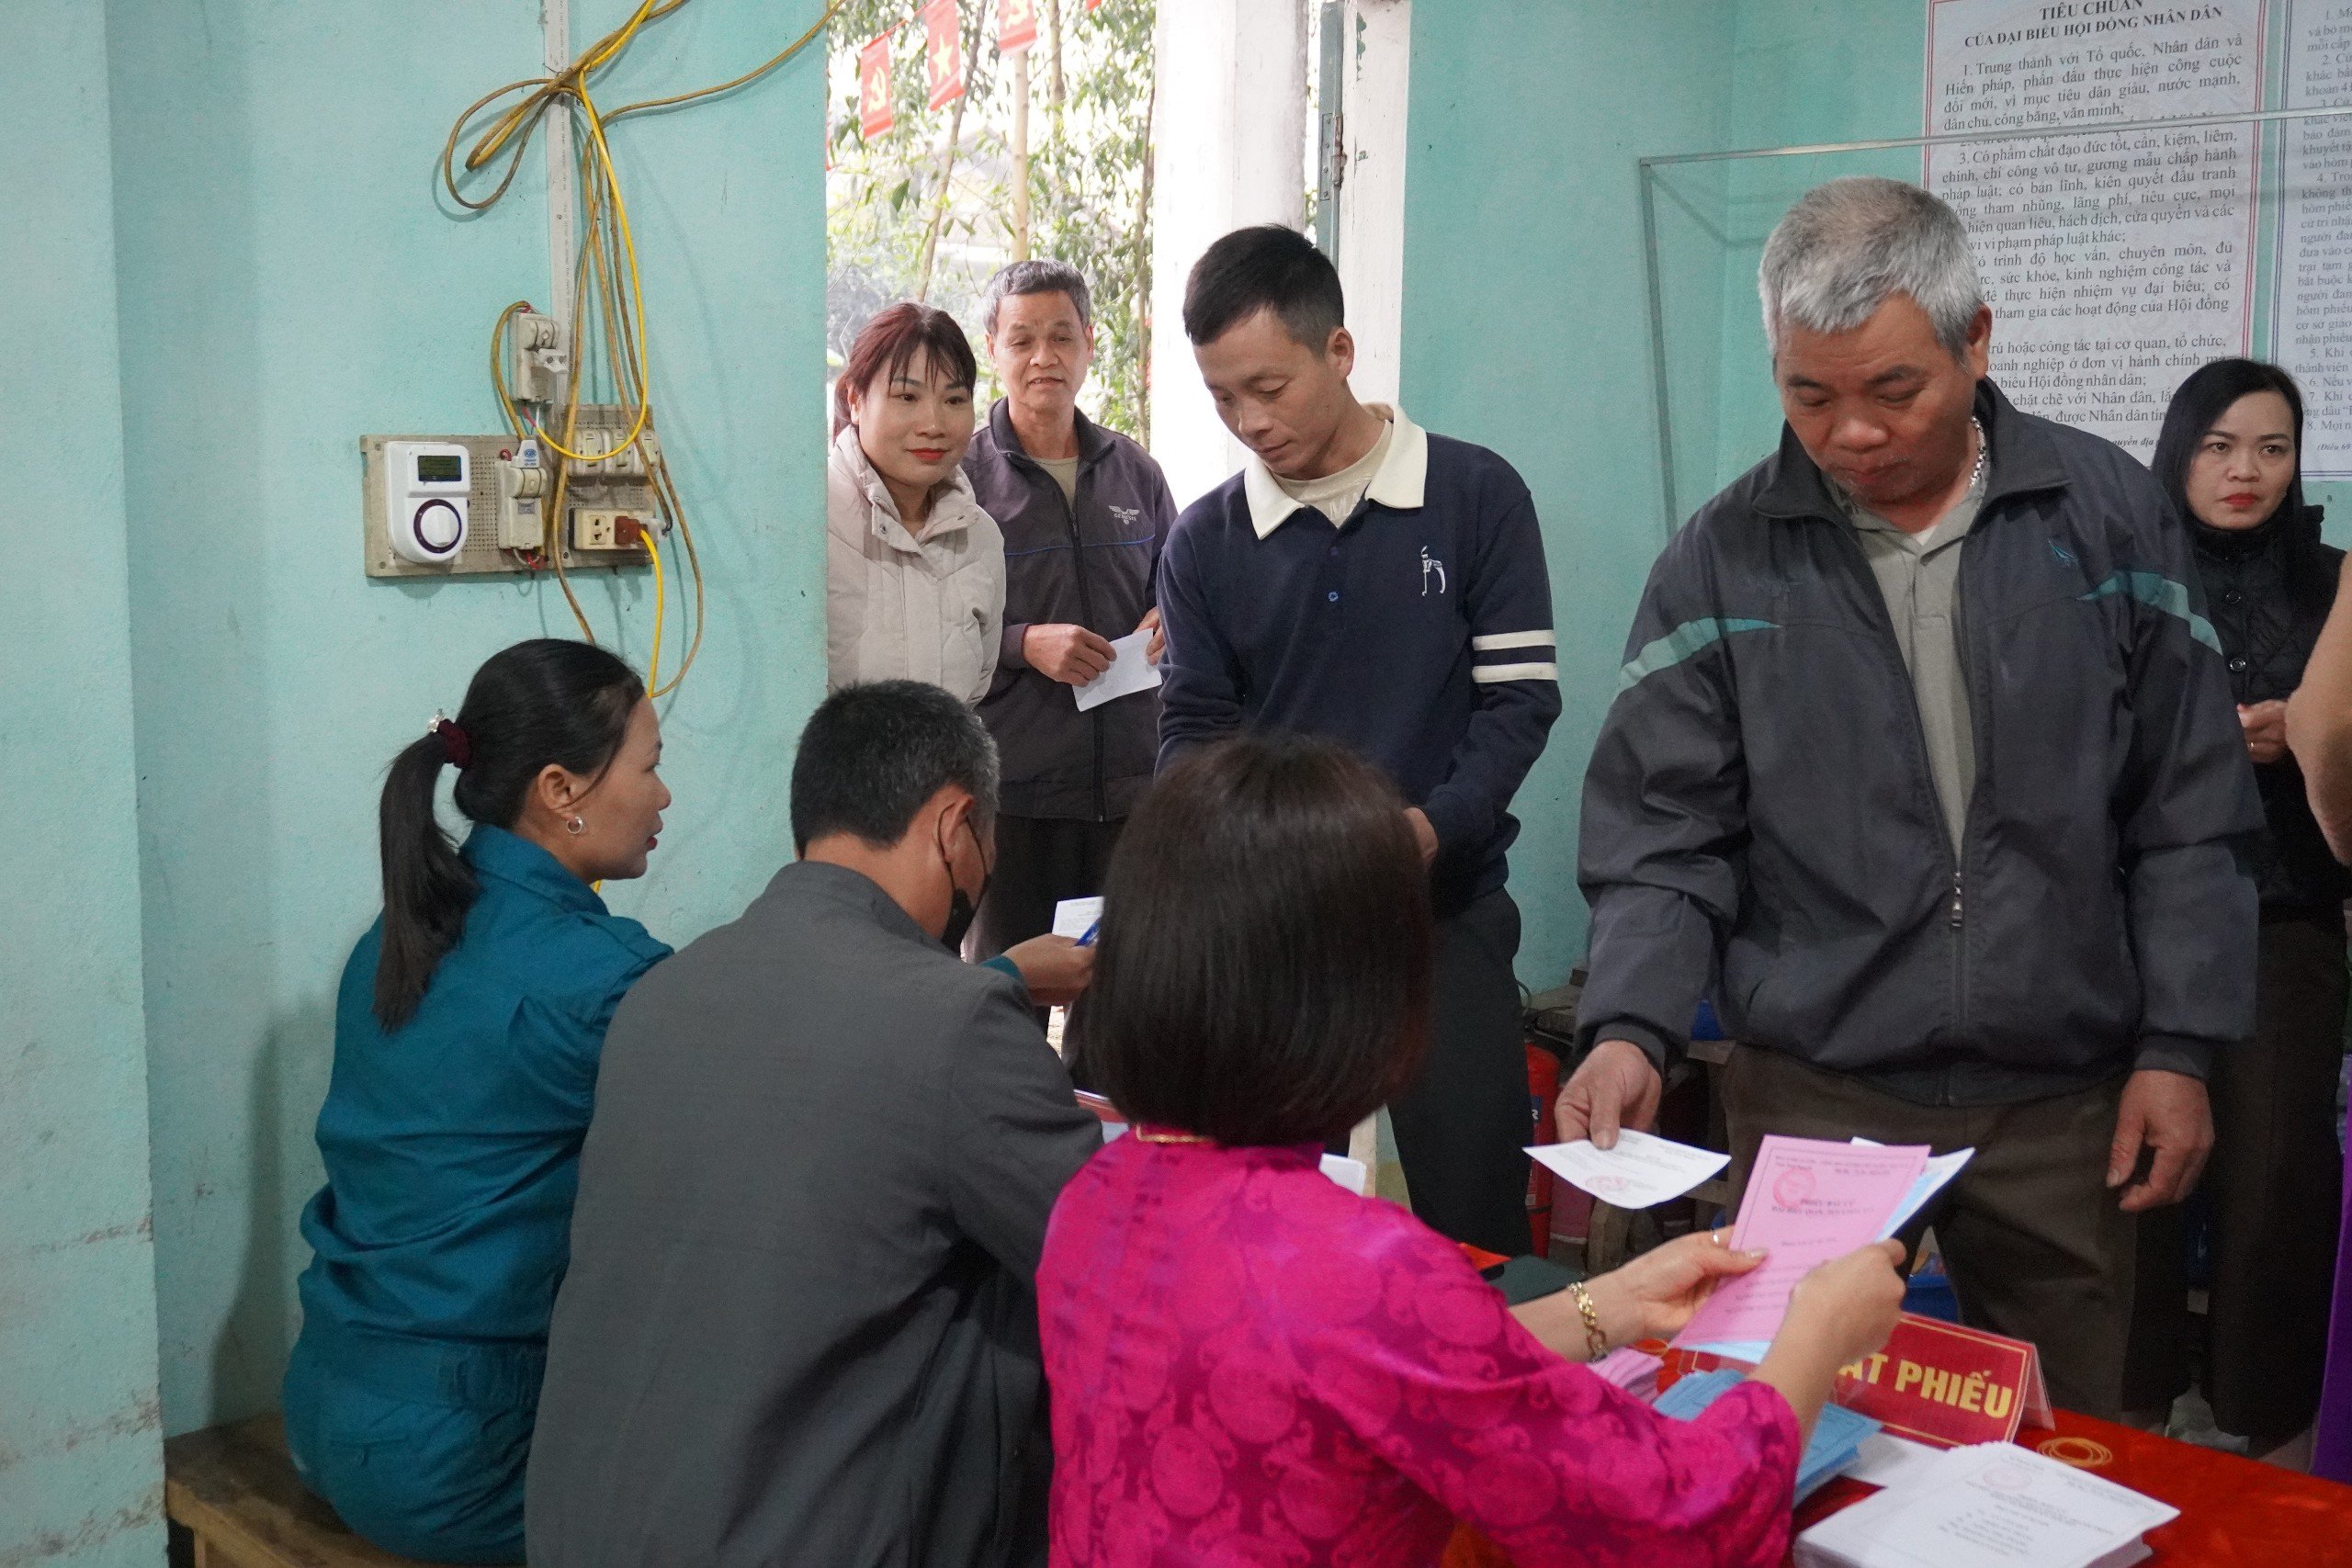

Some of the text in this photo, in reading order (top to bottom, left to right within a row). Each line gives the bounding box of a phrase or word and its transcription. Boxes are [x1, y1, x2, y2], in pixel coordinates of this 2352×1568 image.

[2064, 21, 2091, 37] HỘI
[2143, 8, 2186, 27] NHÂN
[2191, 5, 2222, 20] DÂN
[1977, 62, 2011, 75] Trung
[2019, 55, 2052, 70] thành
[2059, 51, 2079, 65] với
[2154, 41, 2188, 55] Nhân
[2195, 37, 2219, 51] dân
[1946, 54, 2242, 96] Hiến pháp, phấn thực hiện công cuộc
[1971, 98, 1996, 111] mới,
[2023, 94, 2050, 106] mục
[2058, 89, 2080, 101] tiêu
[2088, 85, 2110, 99] dân
[2159, 77, 2191, 91] nước
[1944, 103, 2124, 131] dân công văn minh;
[1959, 153, 1970, 164] 3.
[1973, 150, 1989, 164] Có
[2030, 142, 2054, 158] chất
[2058, 143, 2080, 158] đạo
[2084, 141, 2107, 153] đức
[2110, 136, 2131, 152] tốt,
[2164, 134, 2199, 147] kiệm,
[1942, 170, 1978, 183] chính,
[1984, 166, 2001, 179] chí
[2007, 164, 2038, 179] công
[2044, 163, 2059, 175] vô
[2064, 164, 2081, 174] tư,
[2087, 159, 2128, 175] gương
[2167, 148, 2199, 166] chấp
[2205, 147, 2236, 162] hành
[1942, 165, 2235, 202] pháp luật; có lĩnh, kiên quyết đấu tranh
[1984, 202, 2014, 214] tham
[2141, 190, 2165, 204] tiêu
[2174, 190, 2200, 204] cực,
[2210, 187, 2234, 200] mọi
[1968, 205, 2234, 234] hiện quan liêu, hách dịch, và các
[1970, 231, 2125, 252] vi vi phạm pháp luật khác;
[1995, 243, 2206, 266] trình độ học vấn, chuyên môn,
[2001, 272, 2020, 284] sức
[2066, 268, 2092, 280] kinh
[2099, 265, 2146, 281] nghiệm
[2153, 264, 2184, 277] công
[2190, 261, 2209, 273] tác
[2005, 289, 2031, 302] thực
[2040, 287, 2065, 300] hiện
[2074, 285, 2112, 300] nhiệm
[2122, 286, 2136, 298] vụ
[2144, 282, 2164, 297] đại
[2214, 278, 2230, 290] có
[1996, 294, 2229, 320] tham gia các hoạt động Hội đồng
[2007, 333, 2226, 355] hoặc công tác tại cơ quan, chức,
[2325, 348, 2344, 357] Khi
[1989, 354, 2199, 373] oanh nghiệp vị hành chính
[2030, 373, 2146, 389] Hội đồng nhân dân;
[2013, 391, 2156, 408] chặt với Nhân dân,
[2324, 391, 2342, 400] Khi
[2055, 411, 2086, 424] được
[2089, 410, 2122, 422] Nhân
[2126, 410, 2148, 422] dân
[1894, 1359, 2013, 1419] PHIẾU
